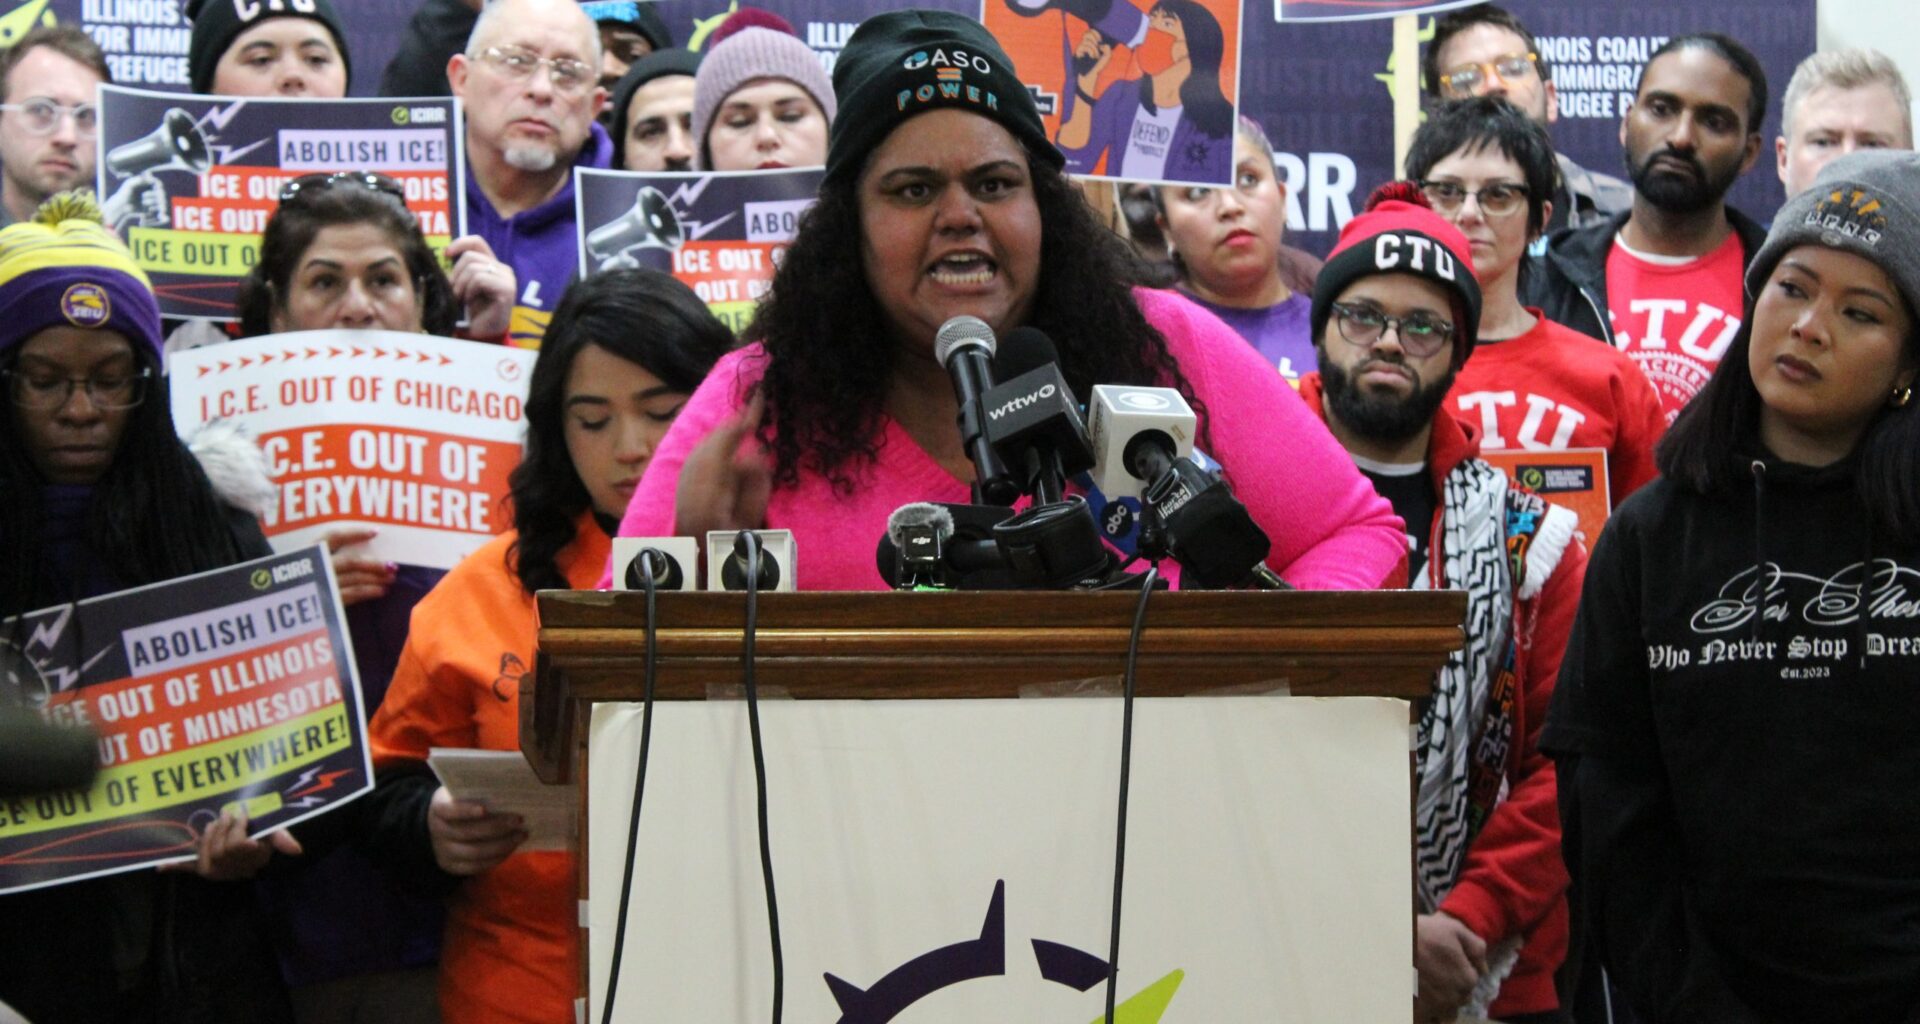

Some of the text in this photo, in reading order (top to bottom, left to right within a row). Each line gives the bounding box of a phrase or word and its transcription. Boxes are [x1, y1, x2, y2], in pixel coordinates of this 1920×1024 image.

[81, 0, 179, 23] ILLINOIS
[897, 83, 998, 112] POWER
[285, 140, 444, 163] ABOLISH ICE!
[200, 174, 241, 199] ICE
[173, 205, 214, 231] ICE
[220, 208, 268, 233] OUT
[134, 239, 172, 262] ICE
[183, 243, 230, 266] OUT
[674, 249, 712, 273] ICE
[718, 248, 763, 271] OUT
[1375, 233, 1456, 281] CTU
[694, 279, 740, 304] OUT
[280, 376, 336, 406] OUT
[349, 375, 383, 402] OF
[395, 379, 522, 422] CHICAGO
[989, 391, 1039, 420] wttw
[349, 430, 428, 476] OUT
[440, 441, 487, 485] OF
[1106, 504, 1128, 535] abc
[272, 557, 314, 584] ICIRR
[133, 595, 322, 668] ABOLISH ICE!
[1698, 637, 1778, 665] Never
[1787, 634, 1848, 661] Stop
[97, 684, 156, 722] OUT
[165, 673, 201, 707] OF
[210, 636, 334, 697] ILLINOIS
[138, 722, 175, 756] OF
[183, 675, 342, 745] MINNESOTA
[106, 775, 140, 807] OF
[151, 713, 348, 797] EVERYWHERE!
